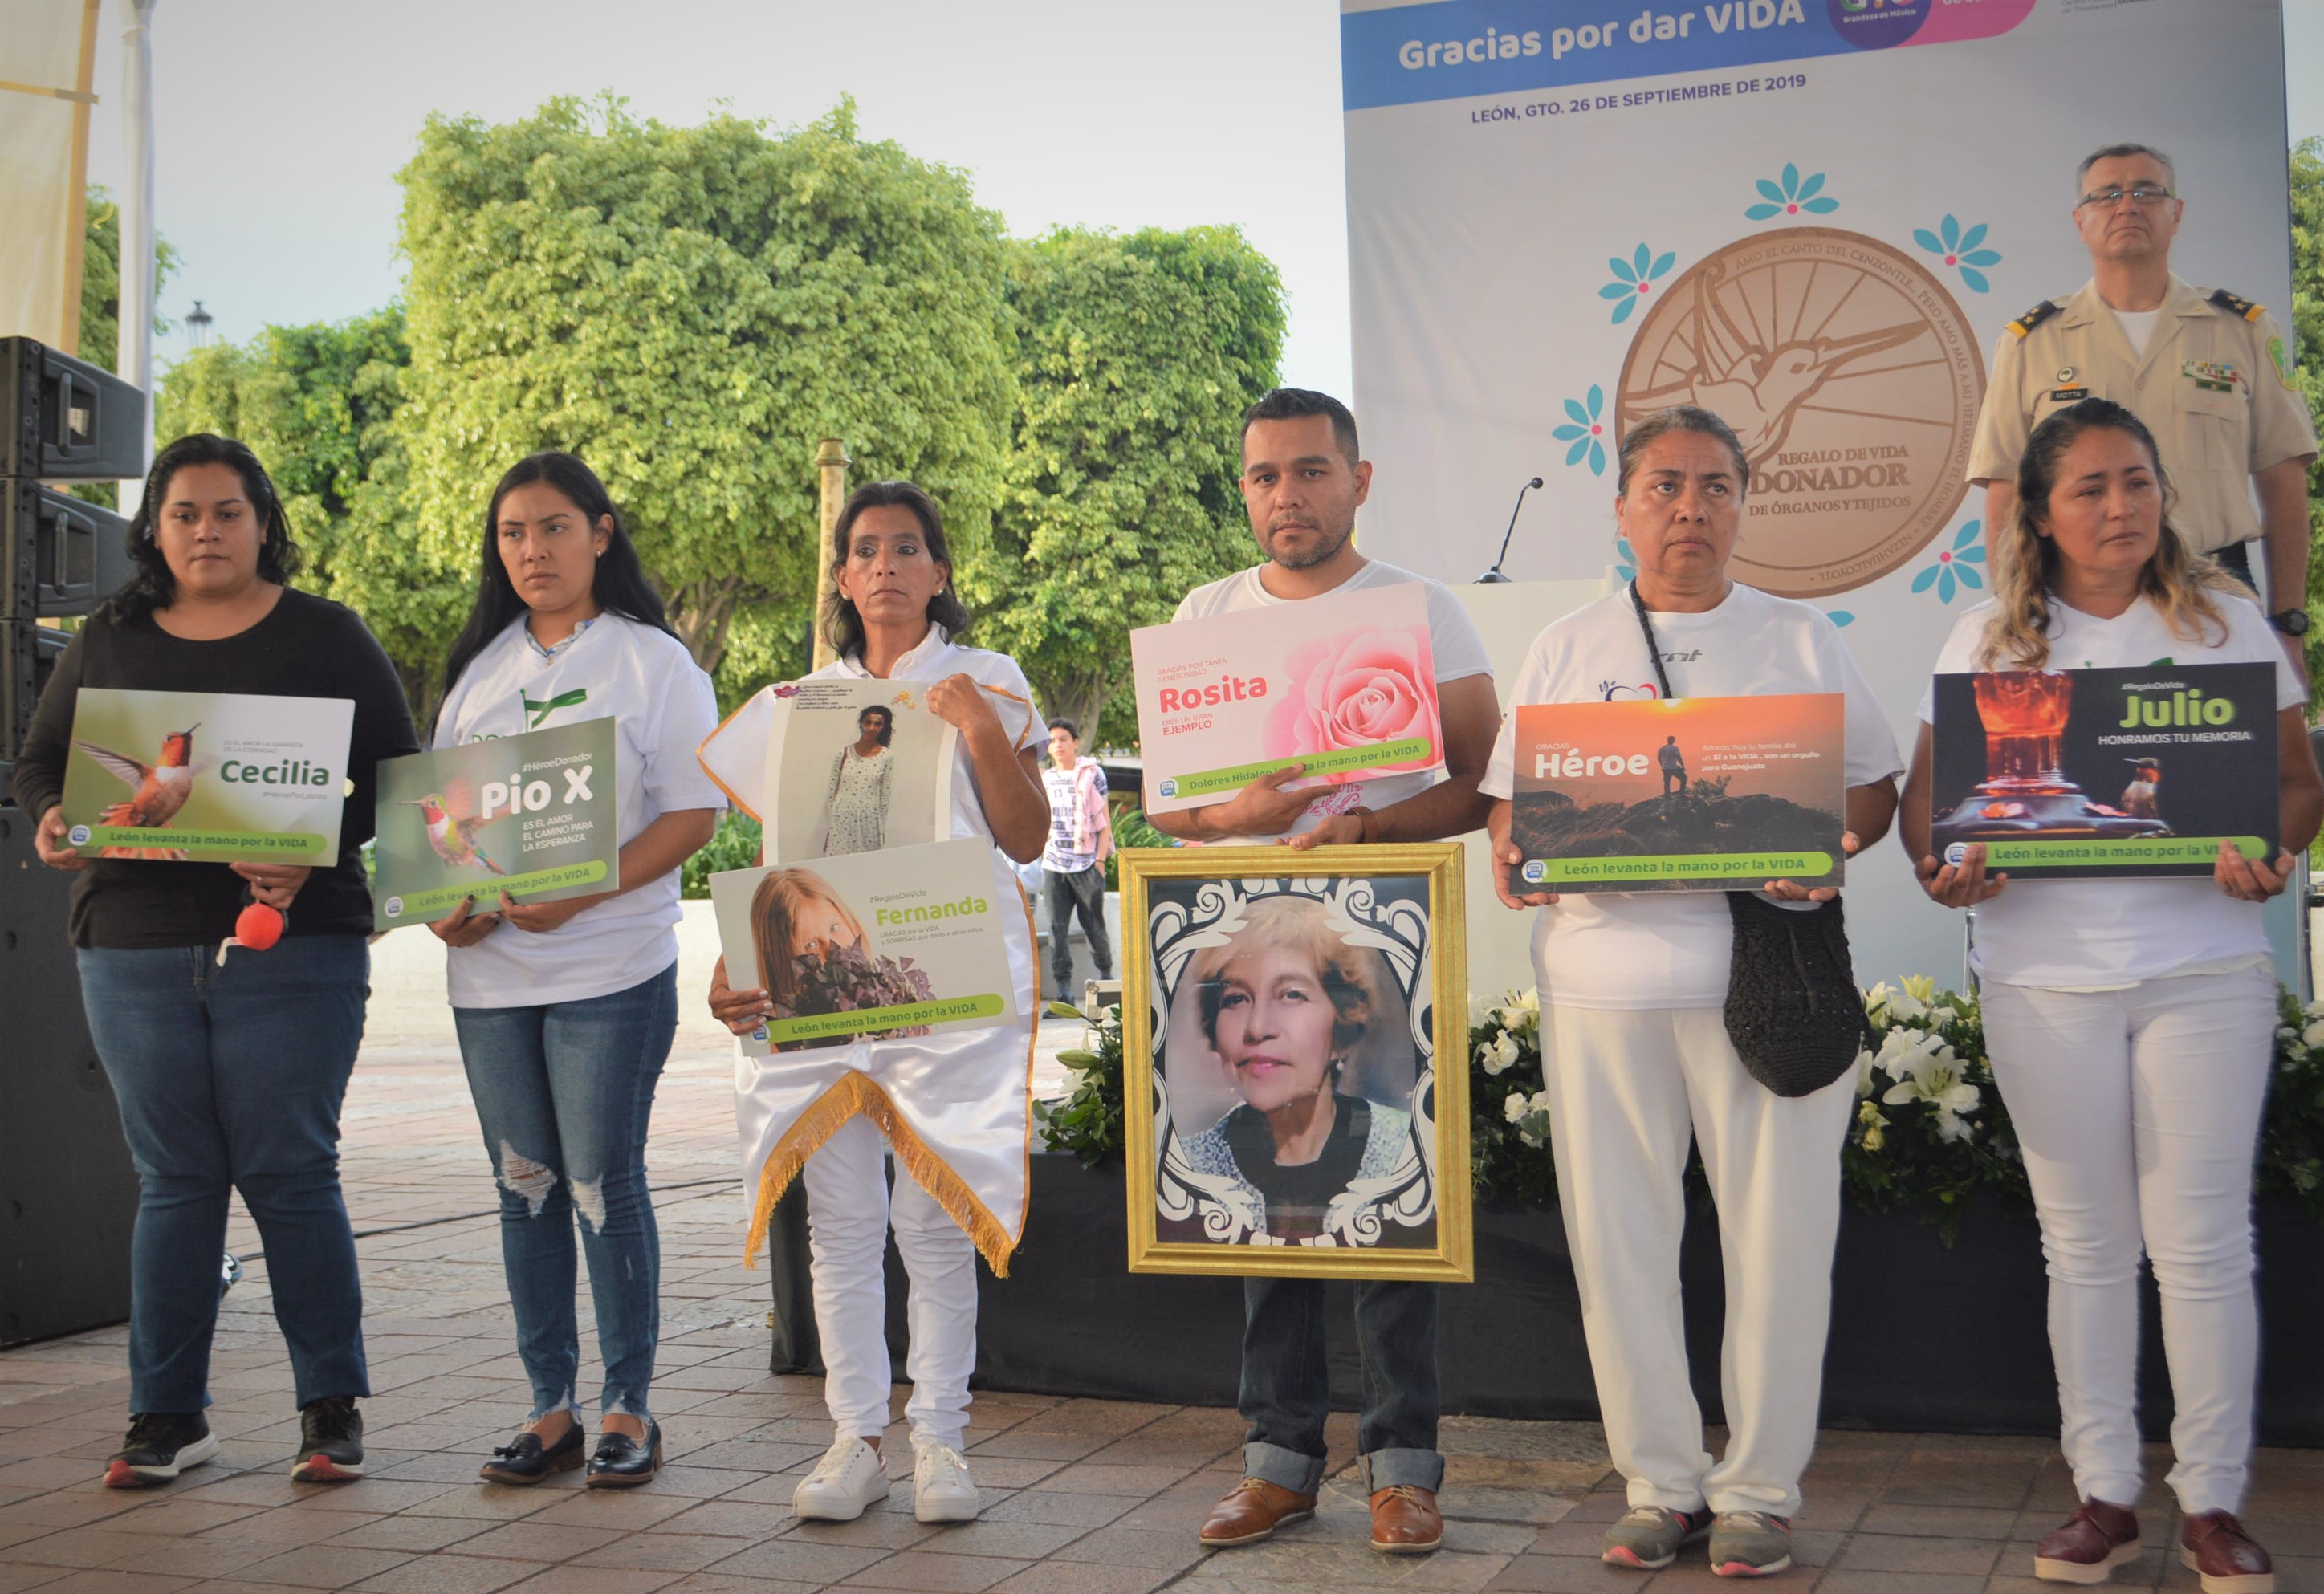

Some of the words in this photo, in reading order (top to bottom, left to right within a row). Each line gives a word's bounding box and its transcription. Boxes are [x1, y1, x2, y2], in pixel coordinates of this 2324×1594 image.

[1878, 11, 1889, 19] de
[1399, 27, 1541, 70] Gracias
[1552, 22, 1618, 60] por
[1628, 10, 1695, 43] dar
[1704, 0, 1805, 34] VIDA
[1471, 105, 1520, 124] LEÓN,
[1525, 102, 1565, 118] GTO.
[1569, 99, 1590, 112] 26
[1596, 96, 1618, 110] DE
[1622, 83, 1732, 107] SEPTIEMBRE
[1736, 79, 1760, 94] DE
[1765, 74, 1806, 91] 2019
[1766, 247, 1779, 258] EL
[1781, 243, 1823, 254] CANTO
[1826, 244, 1847, 258] DEL
[1736, 250, 1763, 270] AMO
[1918, 290, 1942, 318] PERO
[1938, 318, 1958, 345] AMO
[1960, 373, 1970, 383] A
[1960, 384, 1972, 400] MI
[1956, 403, 1974, 465] HERMANO
[1777, 449, 1842, 466] REGALO
[1844, 447, 1867, 462] DE
[1868, 445, 1910, 459] VIDA
[1748, 462, 1911, 495] DONADOR
[1950, 466, 1961, 480] EL
[1749, 504, 1768, 516] DE
[1771, 498, 1841, 515] ÓRGANOS
[1842, 499, 1852, 510] Y
[1851, 495, 1911, 512] TEJIDOS
[1921, 482, 1955, 527] HOMBRE
[1157, 664, 1188, 675] GRACIAS
[1188, 661, 1203, 669] POR
[1204, 657, 1227, 666] TANTA
[1158, 669, 1207, 683] GENEROSIDAD
[1159, 674, 1268, 713] Rosita
[2119, 689, 2235, 728] Julio
[1162, 718, 1179, 726] ERES
[1180, 715, 1192, 723] UN
[1192, 713, 1213, 721] GRAN
[1163, 720, 1213, 736] EJEMPLO
[1536, 742, 1569, 750] GRACIAS
[1733, 743, 1747, 751] hoy
[2098, 734, 2171, 746] HONRAMOS
[2171, 732, 2189, 742] TU
[2192, 731, 2252, 742] MEMORIA
[523, 752, 593, 772] #HéroeDonador
[1535, 747, 1650, 779] Héroe
[1791, 751, 1821, 759] orgullo
[221, 758, 330, 787] Cecilia
[1190, 775, 1230, 790] Dolores
[1316, 760, 1327, 770] la
[1329, 755, 1358, 768] mano
[1360, 752, 1380, 766] por
[1381, 750, 1392, 759] la
[1394, 745, 1420, 758] VIDA
[1721, 762, 1766, 771] Guanajuato
[482, 772, 552, 819] Pio
[564, 765, 593, 804] X
[523, 821, 535, 830] ES
[535, 819, 546, 828] EL
[547, 814, 573, 826] AMOR
[523, 832, 534, 841] EL
[534, 825, 570, 839] CAMINO
[571, 820, 594, 832] PARA
[110, 832, 140, 842] León
[142, 832, 187, 844] levanta
[191, 835, 201, 844] la
[204, 836, 238, 846] mano
[241, 837, 262, 848] por
[265, 837, 275, 847] la
[279, 838, 307, 848] VIDA
[523, 843, 535, 852] LA
[535, 833, 586, 850] ESPERANZA
[1995, 847, 2030, 860] León
[2035, 846, 2090, 859] levanta
[2094, 845, 2107, 857] la
[2111, 846, 2152, 857] mano
[2157, 845, 2184, 860] por
[2187, 844, 2200, 856] la
[1565, 862, 1598, 875] León
[1603, 861, 1659, 874] levanta
[1662, 860, 1674, 872] la
[1678, 862, 1719, 872] mano
[1723, 861, 1748, 873] por
[1752, 859, 1765, 870] la
[1768, 858, 1805, 869] VIDA
[419, 895, 445, 907] León
[488, 884, 498, 895] la
[531, 876, 551, 889] por
[551, 873, 562, 883] la
[564, 868, 591, 881] VIDA
[869, 889, 926, 904] #RegaloDeVida
[876, 895, 987, 926] Fernanda
[880, 929, 906, 938] GRACIAS
[886, 936, 916, 945] SONRISAS
[791, 1023, 819, 1035] León
[820, 1017, 864, 1032] levanta
[866, 1015, 877, 1026] la
[879, 1011, 912, 1024] mano
[914, 1008, 934, 1022] por
[936, 1006, 947, 1016] la
[949, 1002, 978, 1015] VIDA
